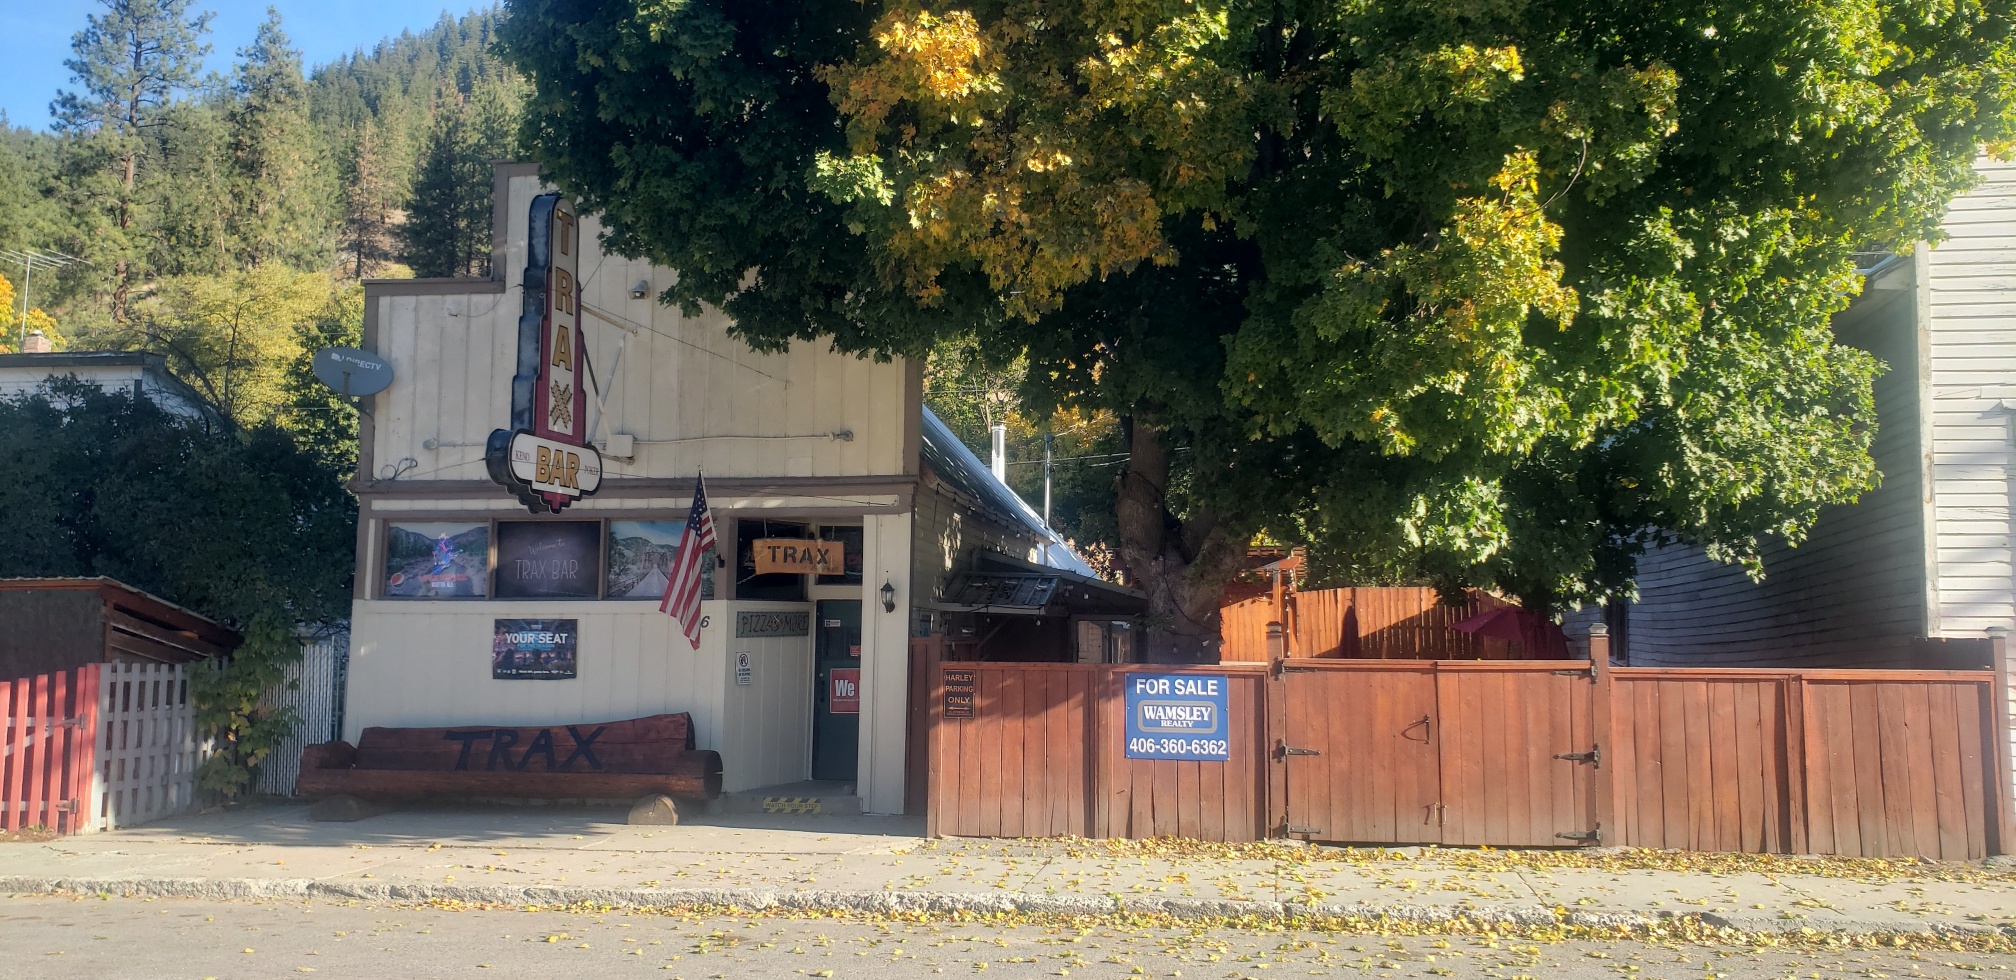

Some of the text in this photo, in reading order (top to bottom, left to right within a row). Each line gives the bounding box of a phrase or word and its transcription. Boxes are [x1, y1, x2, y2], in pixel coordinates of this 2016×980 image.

[550, 209, 574, 429] TRAX
[515, 450, 531, 461] KENO
[535, 445, 581, 490] BAR
[584, 465, 600, 476] POKER
[528, 538, 566, 555] Welcome to
[767, 546, 830, 565] TRAX
[515, 559, 579, 580] TRAX BAR
[700, 615, 711, 628] 6
[505, 633, 568, 644] YOUR SEAT
[945, 674, 974, 682] HARLEY
[834, 679, 855, 697] We
[945, 685, 974, 693] PARKING
[1136, 678, 1219, 696] FOR SALE
[947, 696, 971, 704] ONLY
[1143, 705, 1211, 721] WAMSLEY
[1160, 719, 1194, 728] REALTY
[443, 725, 607, 772] TRAX
[1129, 737, 1227, 755] 406-360-6362
